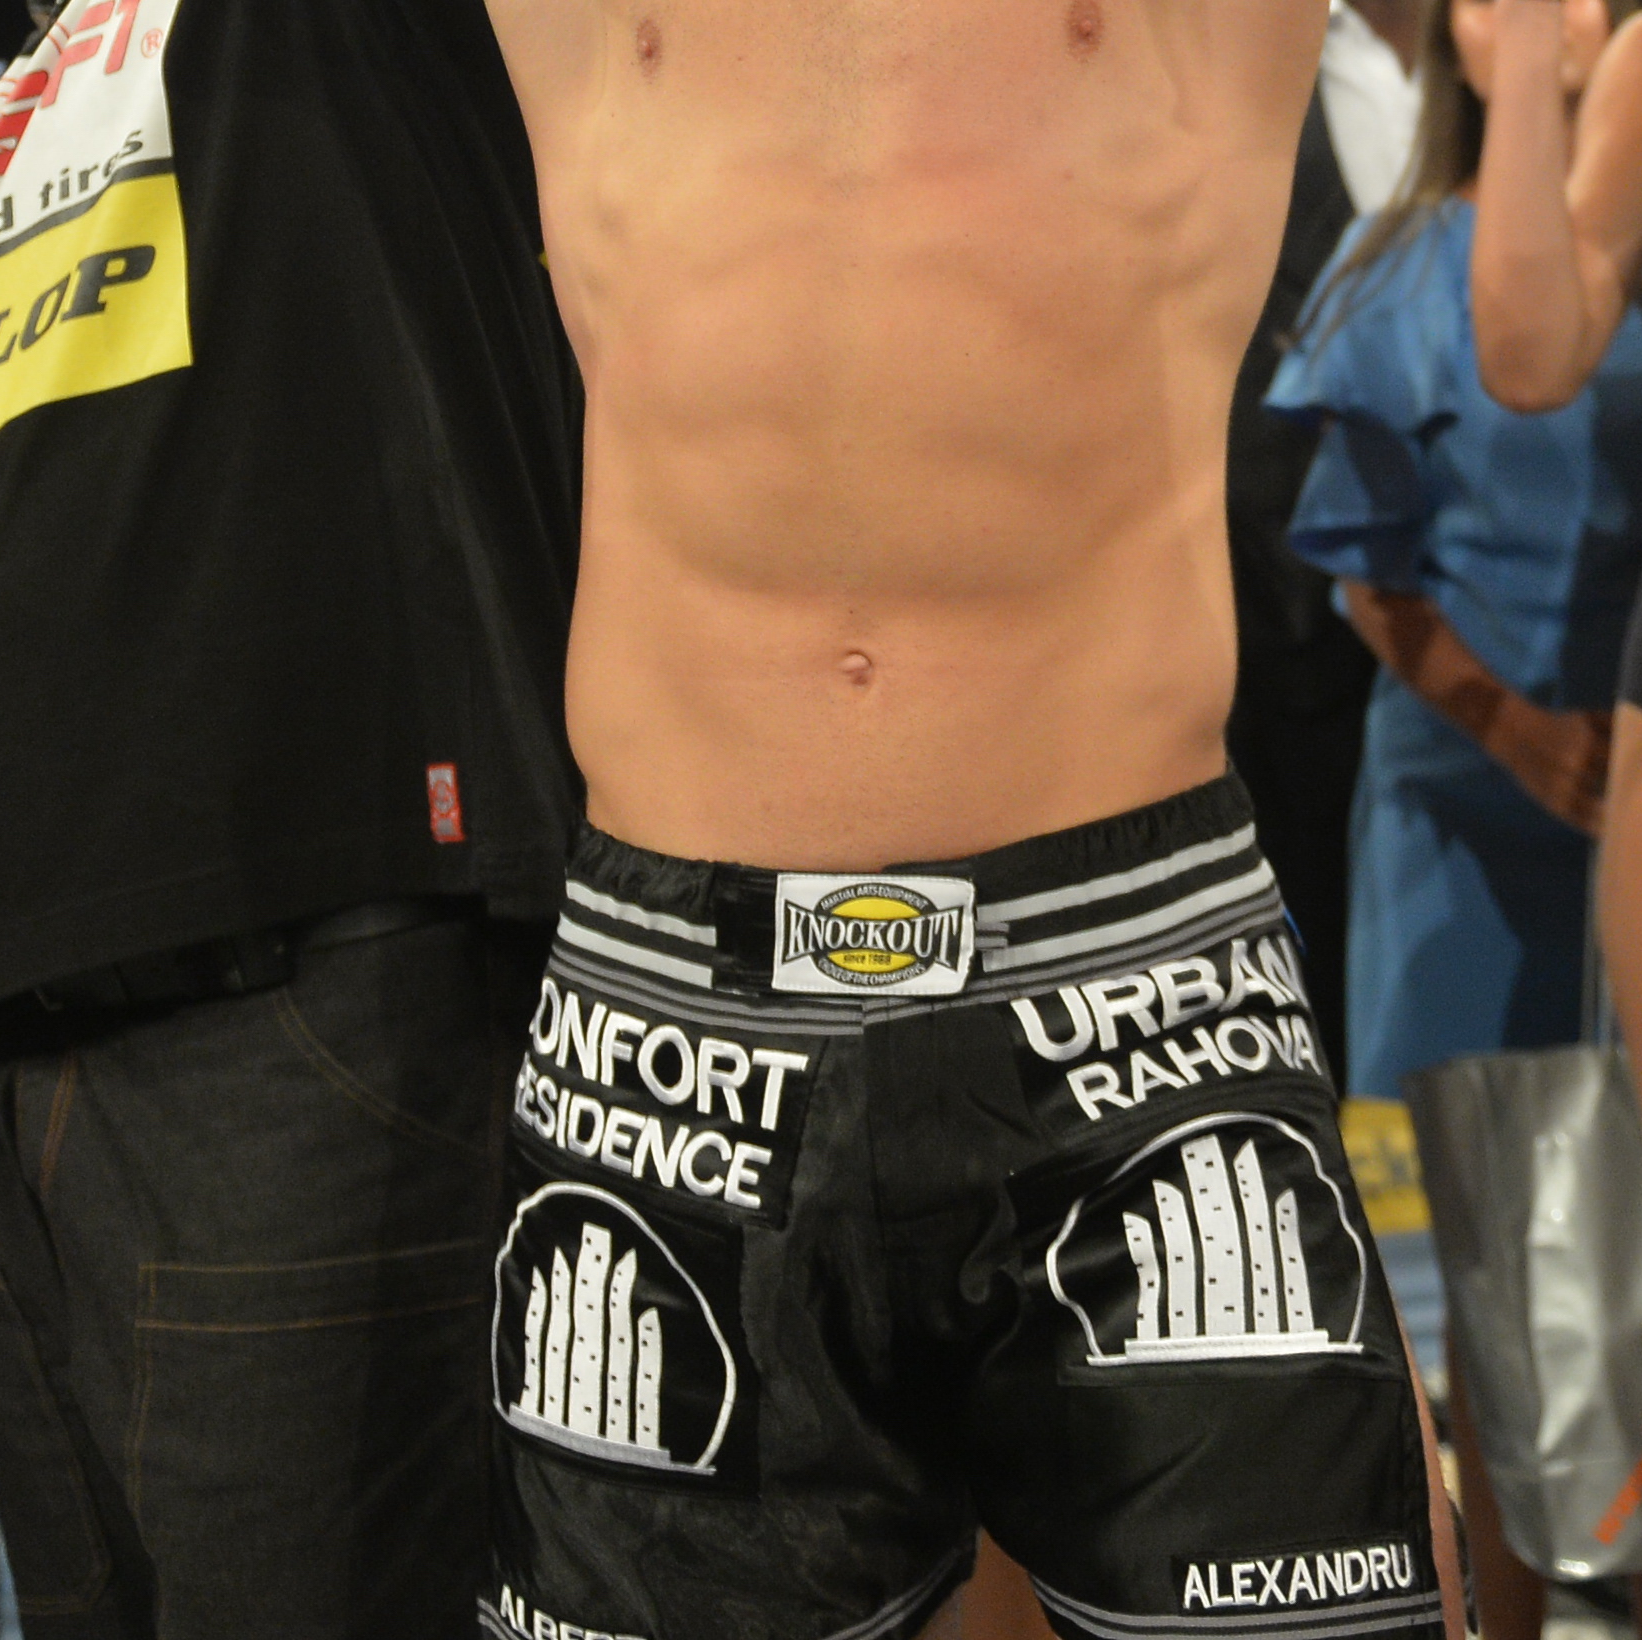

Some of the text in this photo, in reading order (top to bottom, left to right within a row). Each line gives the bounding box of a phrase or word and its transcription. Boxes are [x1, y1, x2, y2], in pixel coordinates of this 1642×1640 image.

[785, 903, 959, 968] KNOCKOUT
[528, 976, 809, 1131] ONFORT
[1010, 934, 1309, 1062] URBAN
[1066, 1014, 1322, 1121] RAHOVA
[514, 1051, 772, 1209] ESIDENCE
[1183, 1544, 1412, 1609] ALEXANDRU
